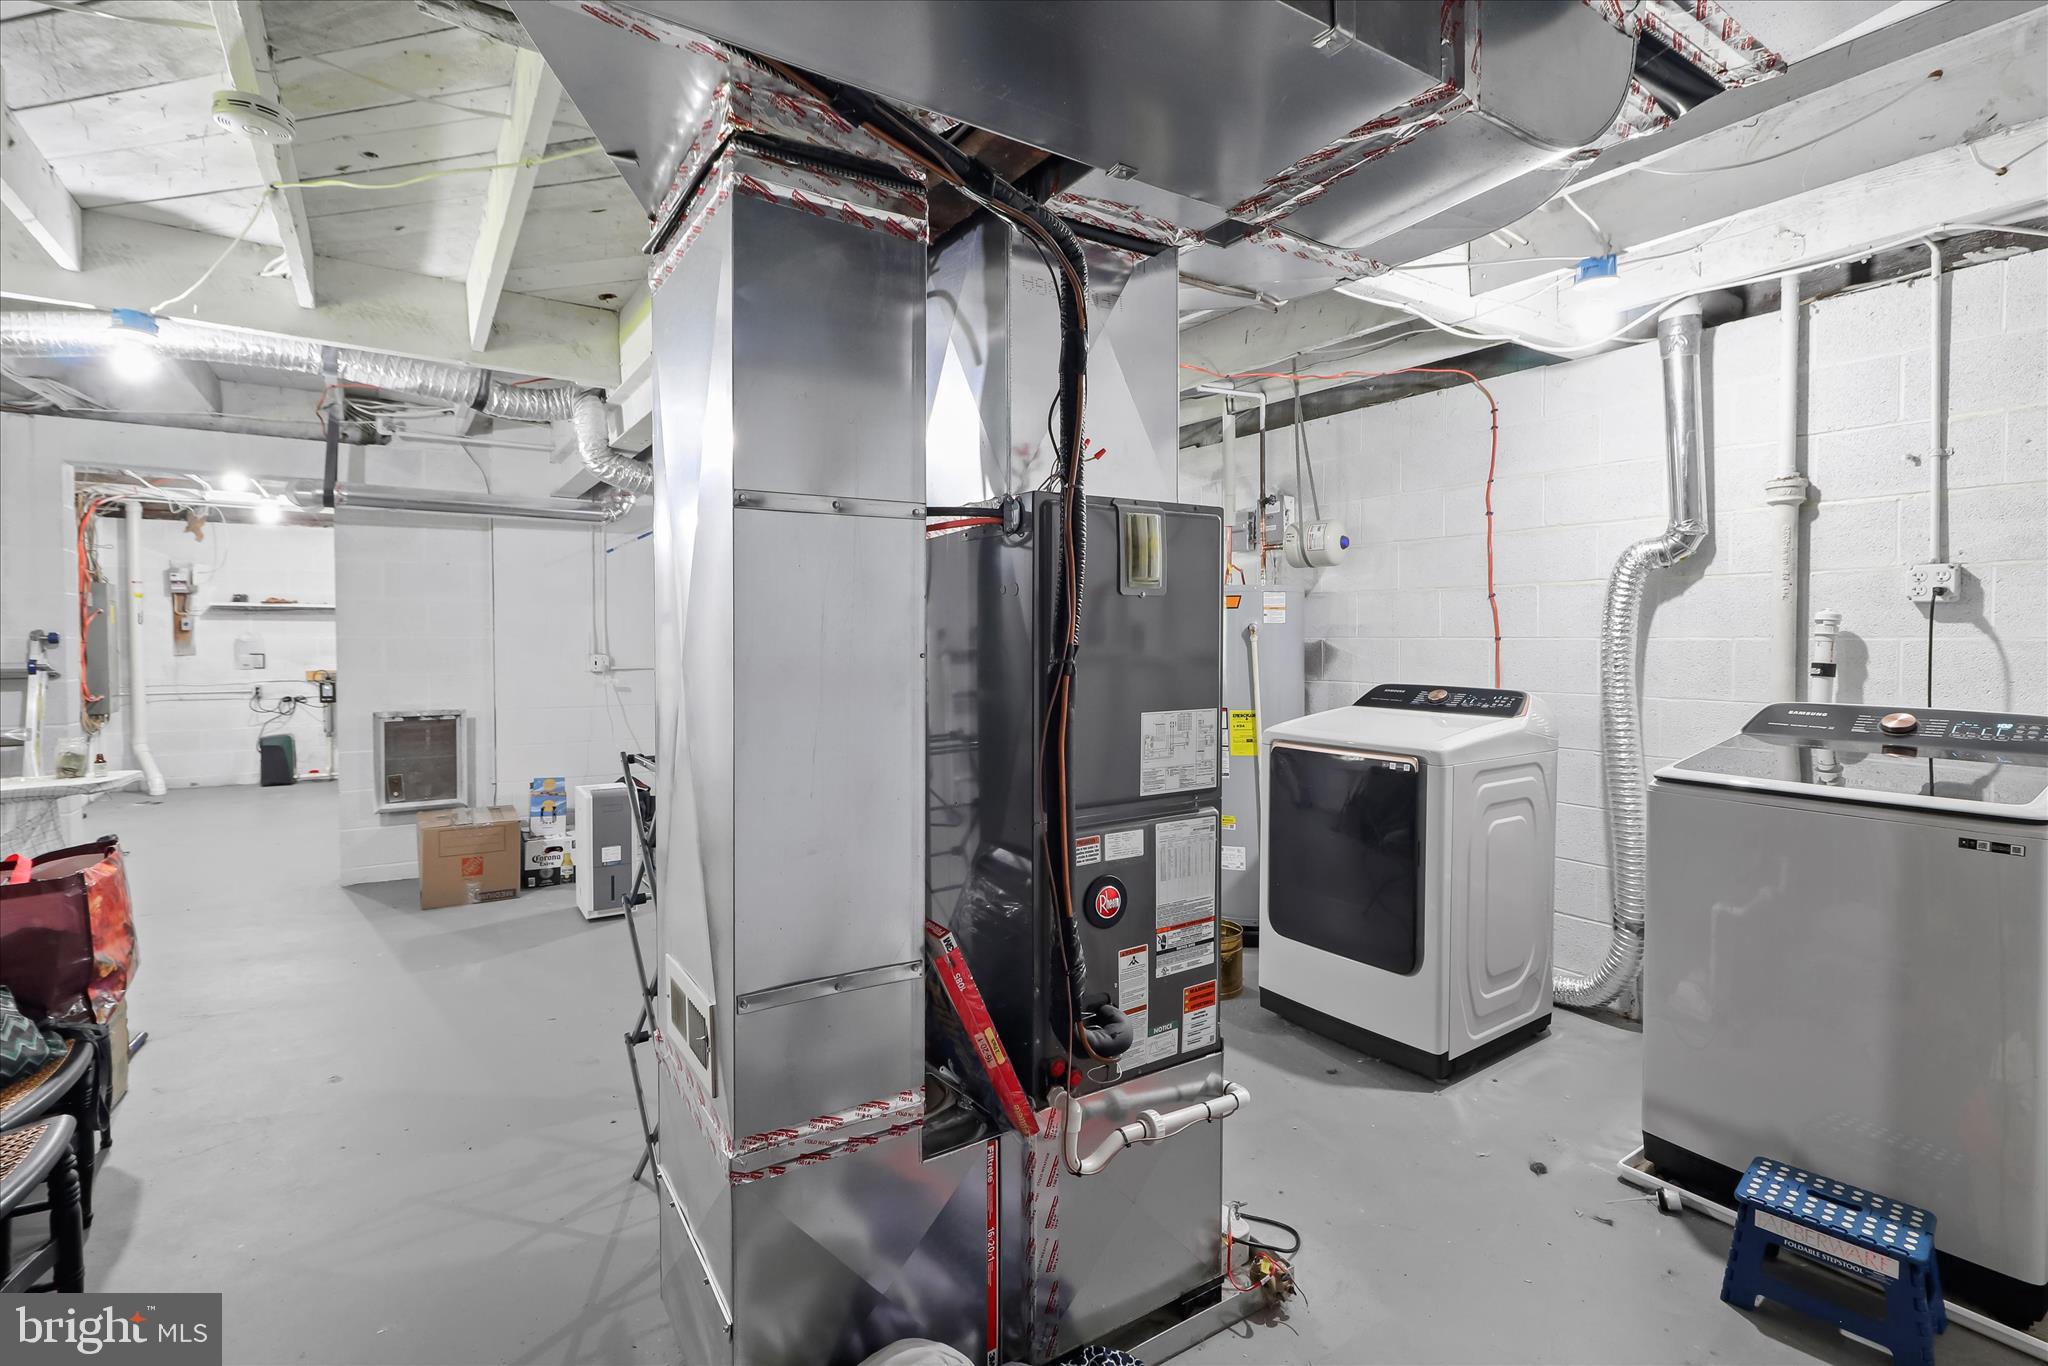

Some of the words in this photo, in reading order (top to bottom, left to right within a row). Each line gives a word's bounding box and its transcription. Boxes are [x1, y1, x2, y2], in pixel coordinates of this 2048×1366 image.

[532, 854, 561, 864] Corona
[943, 936, 955, 953] 3M
[953, 972, 967, 992] 1085
[1153, 1023, 1173, 1034] NOTICE
[986, 1145, 995, 1184] Filtrete
[1783, 1239, 1821, 1258] FOLDABLE
[1821, 1252, 1865, 1275] STEPSTOOL
